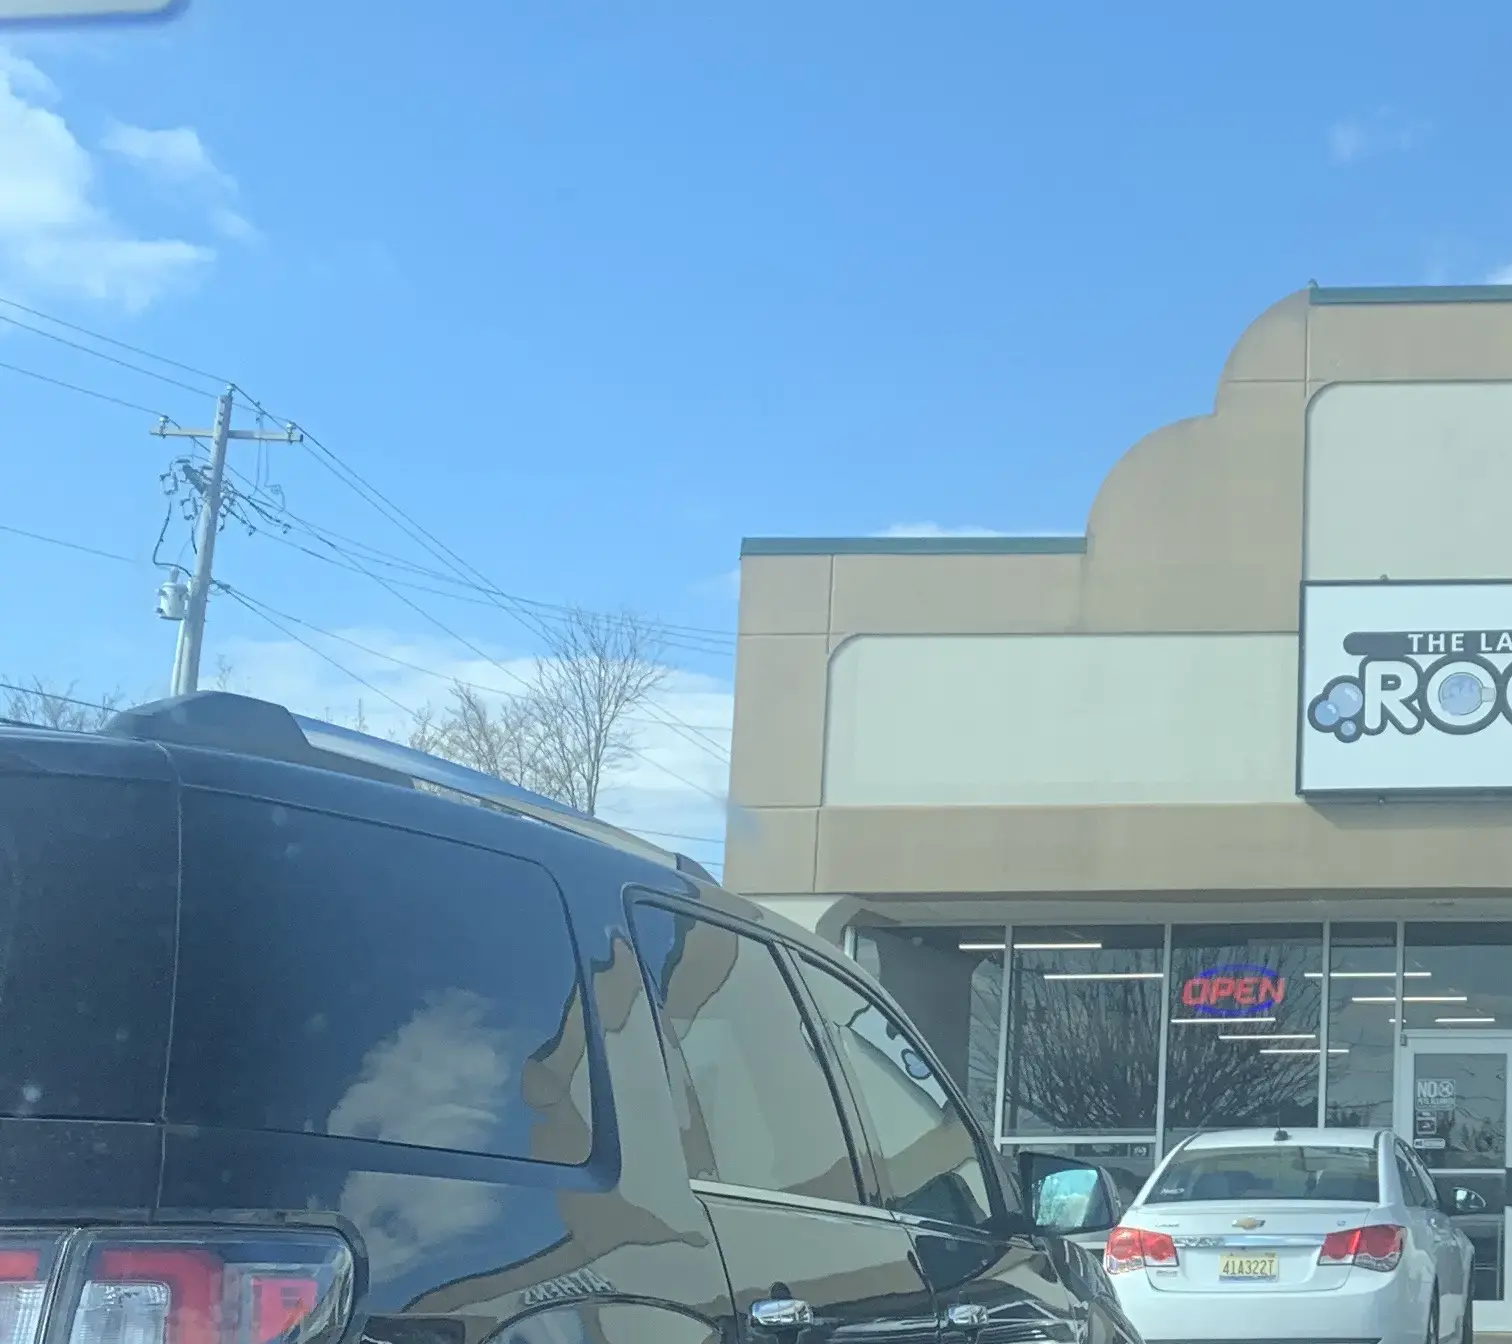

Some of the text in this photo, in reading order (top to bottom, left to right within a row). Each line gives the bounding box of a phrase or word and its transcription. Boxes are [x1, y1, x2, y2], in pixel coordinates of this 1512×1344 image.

[1408, 633, 1465, 653] THE
[1182, 976, 1286, 1006] OPEN
[1417, 1081, 1438, 1098] NO
[1222, 1259, 1275, 1275] 41A322T
